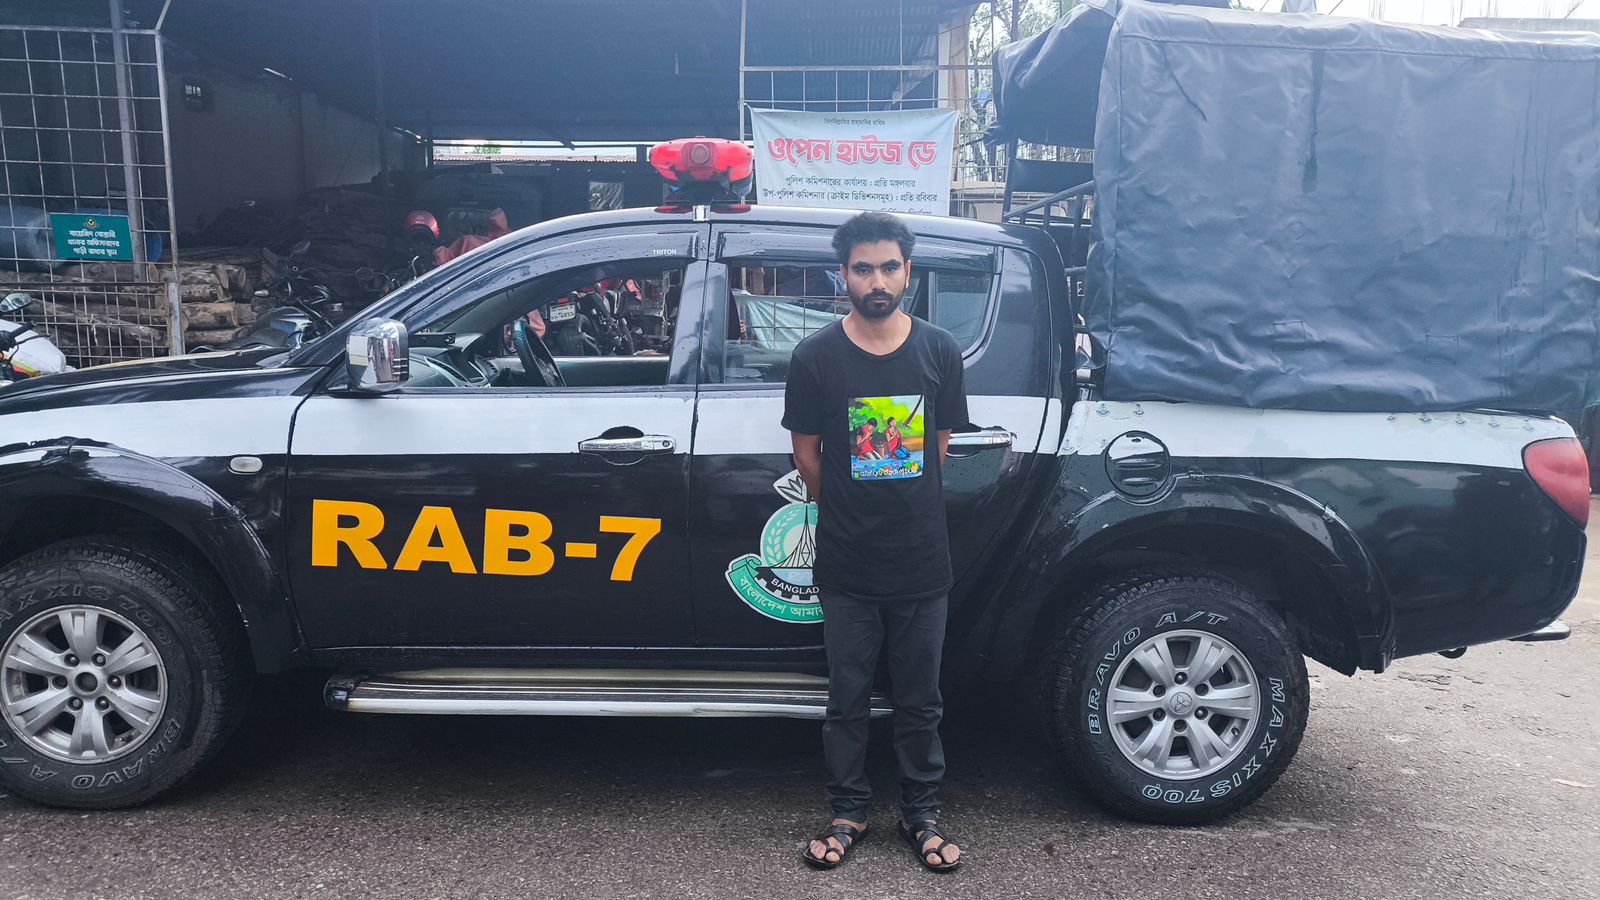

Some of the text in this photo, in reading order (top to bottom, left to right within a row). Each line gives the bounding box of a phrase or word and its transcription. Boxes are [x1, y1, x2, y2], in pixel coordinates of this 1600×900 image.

[767, 134, 938, 170] ওপেন হাউজ ডে
[762, 188, 794, 200] উপ-পুলিশ
[796, 188, 825, 199] কমিশনার
[900, 191, 914, 202] প্রতি
[916, 192, 938, 202] রবিবার
[785, 175, 804, 186] পুলিশ
[805, 176, 841, 186] কমিশনারের
[843, 176, 868, 187] কার্যালয়
[874, 176, 889, 187] প্রতি
[889, 179, 916, 187] মঙ্গলবার
[311, 499, 662, 582] RAB-7
[739, 575, 787, 615] বাংলাদেশ
[771, 577, 820, 594] BANGLAD
[1088, 611, 1229, 734] BRAVO A/T
[71, 718, 181, 789] BRAVO
